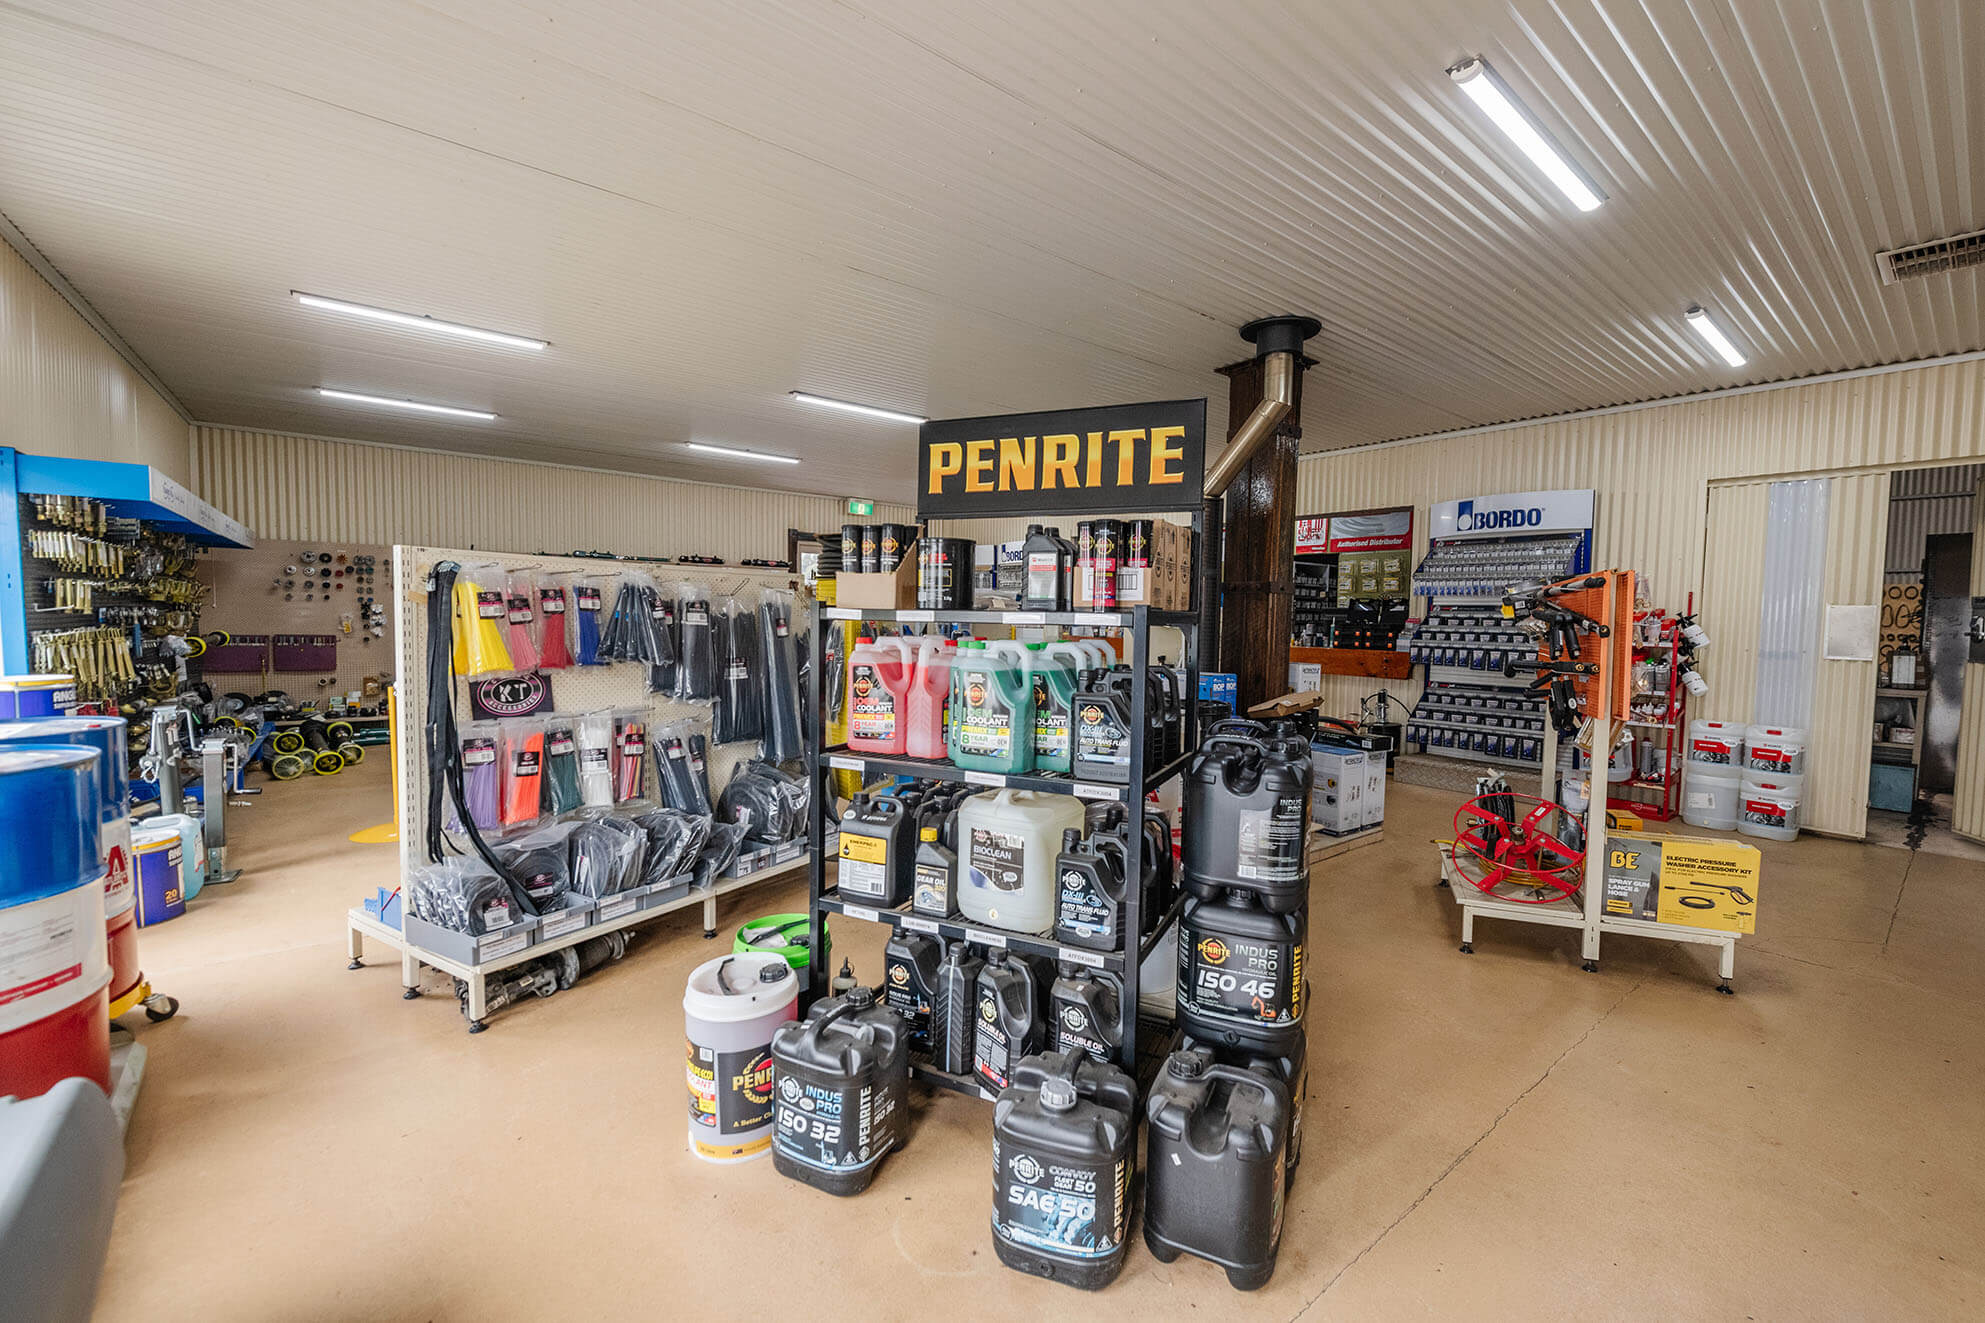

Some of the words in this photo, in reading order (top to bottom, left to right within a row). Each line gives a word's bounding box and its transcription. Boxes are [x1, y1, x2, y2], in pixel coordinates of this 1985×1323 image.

[928, 426, 1185, 494] PENRITE
[1474, 508, 1542, 530] BORDO
[1006, 551, 1023, 562] BORD
[857, 704, 893, 712] COOLANT
[854, 721, 861, 731] 8
[966, 716, 1009, 727] COOLANT
[1037, 718, 1067, 727] OLANT
[962, 734, 970, 745] 8
[1280, 799, 1302, 807] INDUS
[973, 845, 1012, 860] BIOCLEAN
[1610, 850, 1641, 870] BE
[1666, 855, 1699, 863] ELECTRIC
[1700, 859, 1737, 867] PRESSURE
[1666, 861, 1696, 869] WASHER
[1697, 864, 1739, 873] ACCESSORY
[1608, 878, 1633, 886] SPRAY
[1608, 884, 1633, 892] LANCE
[164, 889, 177, 899] 20
[1061, 903, 1076, 911] AUTO
[1093, 908, 1109, 916] FLUID
[1198, 943, 1231, 958] PENRITE
[1235, 944, 1278, 960] INDUS
[1248, 957, 1278, 971] PRO
[1292, 944, 1303, 1003] PENRITE
[1197, 969, 1237, 992] ISO
[1240, 979, 1276, 999] 46
[904, 1009, 915, 1020] 32
[978, 1018, 999, 1038] SOLUBLE
[1060, 1031, 1092, 1049] SOLUBLE
[1092, 1042, 1105, 1053] OIL
[732, 1067, 773, 1091] PENR
[806, 1084, 843, 1104] INDUS
[816, 1100, 842, 1114] PRO
[859, 1085, 872, 1146] PENRITE
[778, 1106, 808, 1133] ISO
[810, 1121, 841, 1144] 32
[1008, 1159, 1045, 1178] PENRITE
[1048, 1165, 1097, 1181] CONVOY
[1054, 1181, 1073, 1191] GEAR
[1074, 1180, 1097, 1193] 50
[1113, 1159, 1125, 1228] PENRITE
[1008, 1184, 1056, 1214] SAE
[1059, 1197, 1096, 1221] 50
